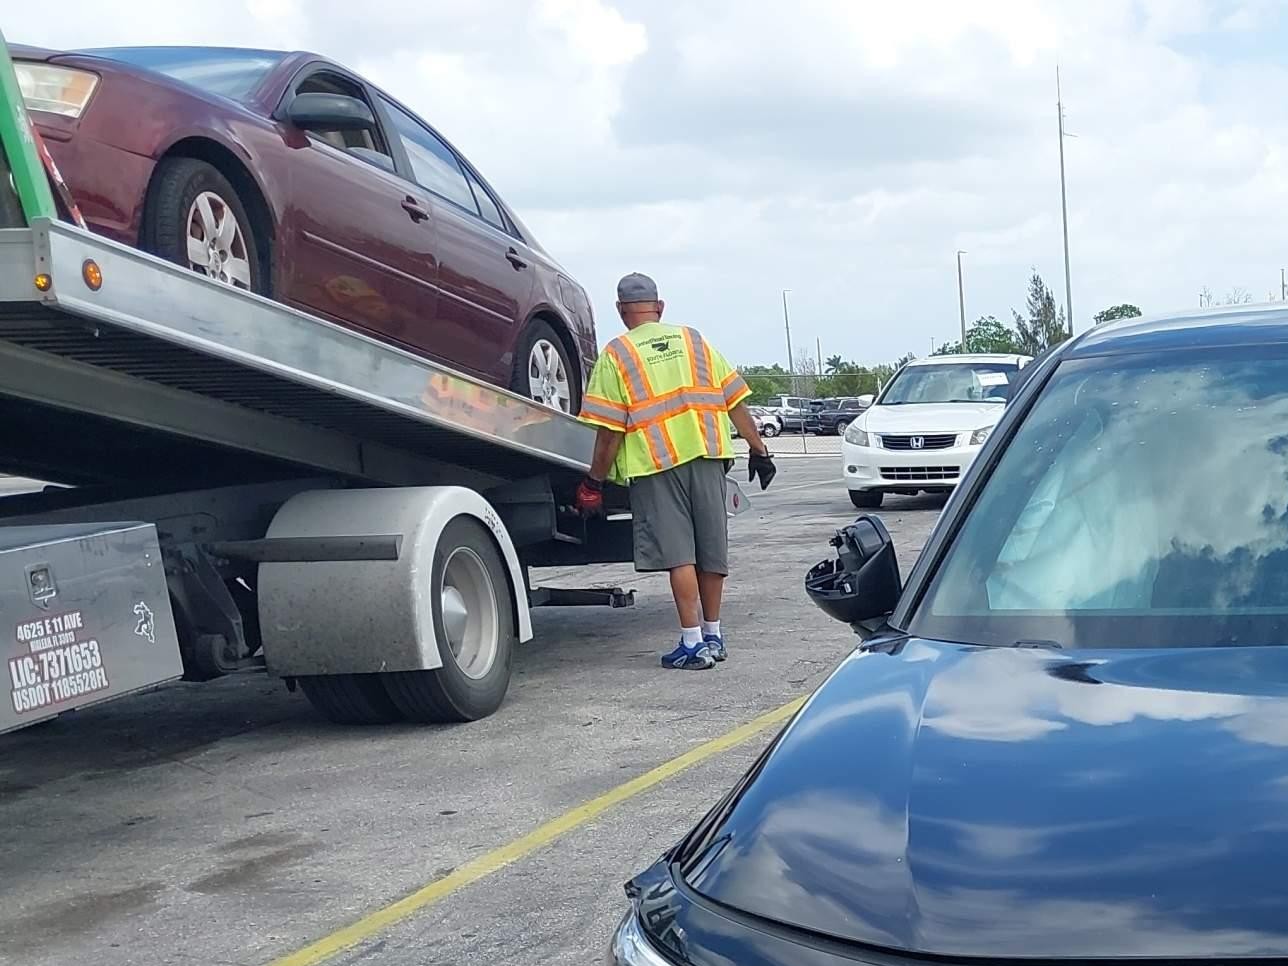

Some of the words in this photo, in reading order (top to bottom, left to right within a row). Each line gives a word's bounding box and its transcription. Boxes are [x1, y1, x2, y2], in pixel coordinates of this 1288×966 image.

[17, 621, 45, 641] 4625
[45, 619, 52, 635] E
[52, 617, 63, 632] 11
[63, 612, 83, 630] AVE
[12, 683, 51, 712] USDOT
